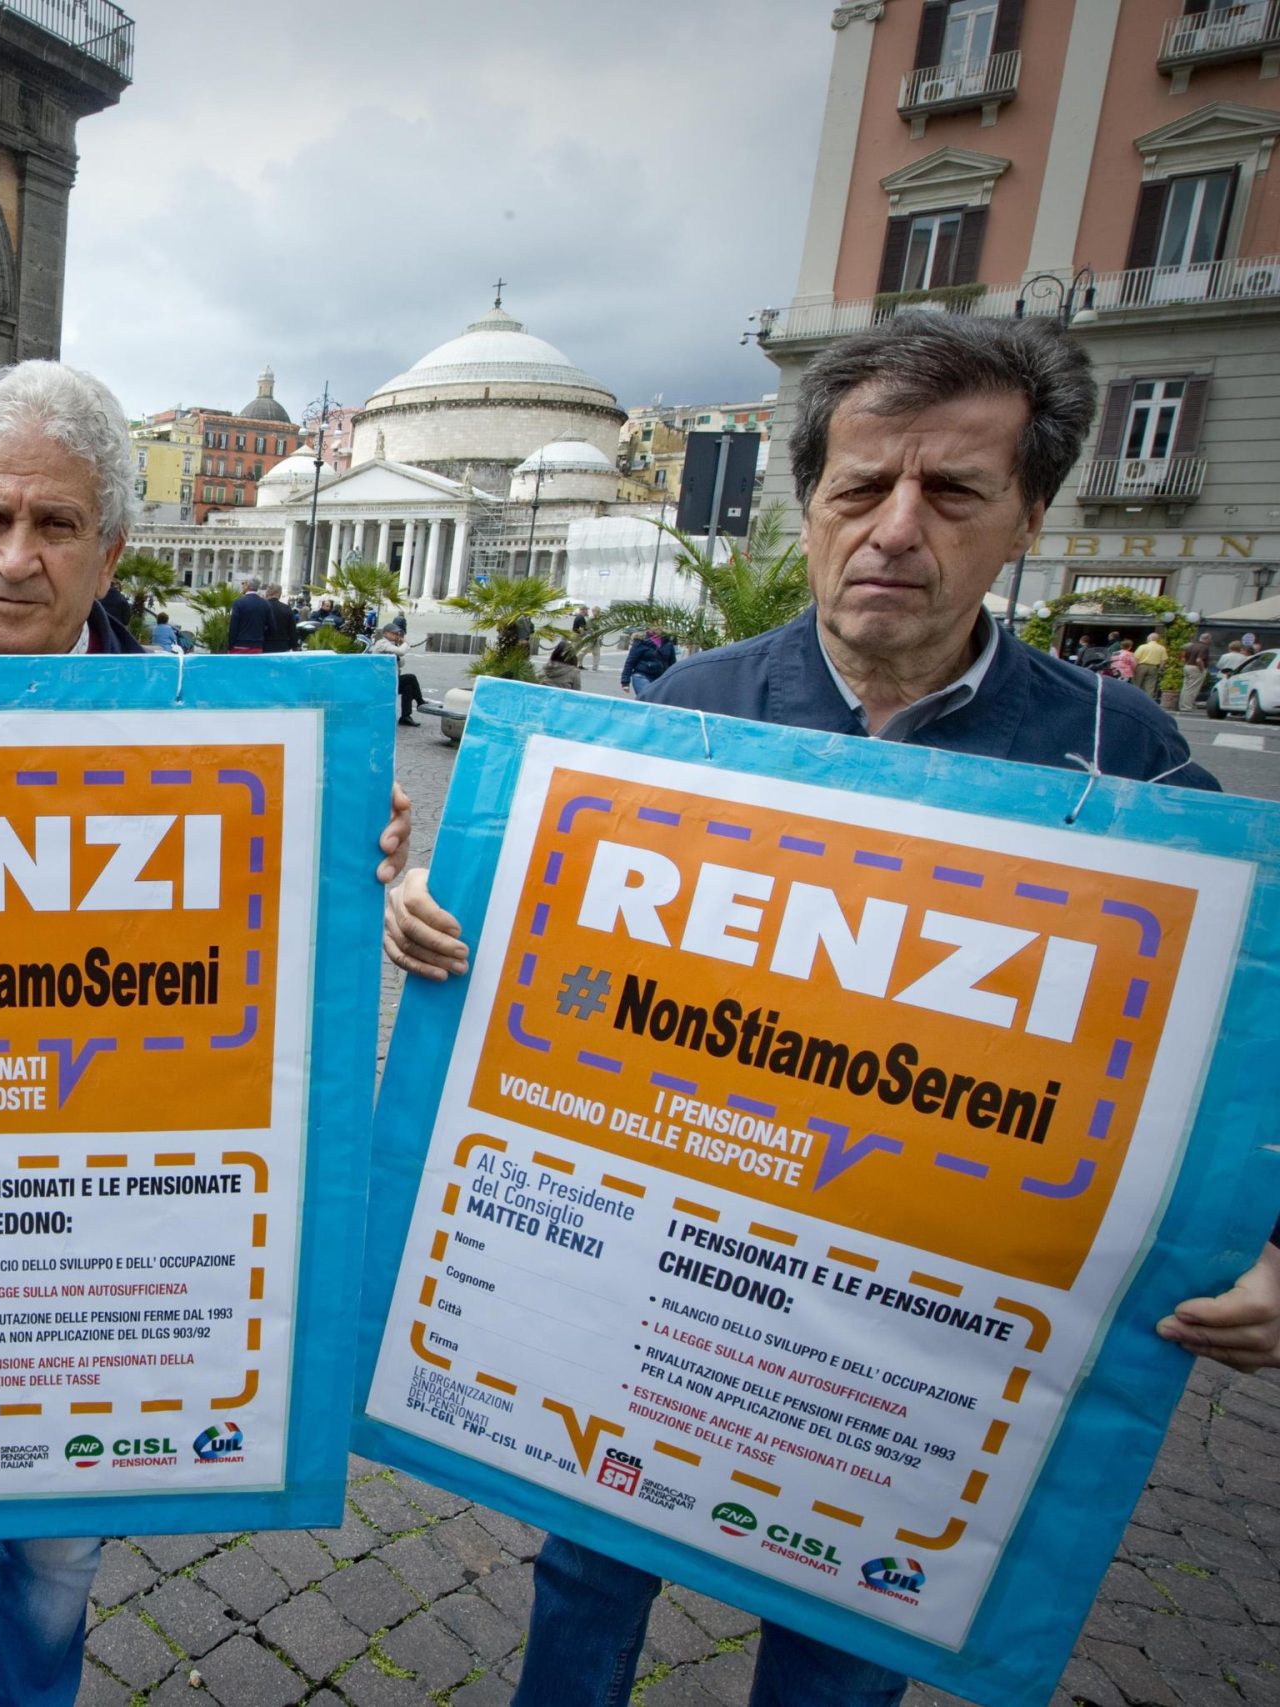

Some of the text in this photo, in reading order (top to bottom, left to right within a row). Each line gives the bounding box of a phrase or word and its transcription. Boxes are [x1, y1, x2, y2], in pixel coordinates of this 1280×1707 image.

[577, 839, 1097, 1043] RENZI
[499, 1073, 804, 1188] VOGLIONO DELLE RISPOSTE
[654, 1090, 813, 1159] I PENSIONATI
[81, 1177, 92, 1196] E
[98, 1177, 120, 1196] LE
[126, 1174, 241, 1195] PENSIONATE
[477, 1153, 635, 1221] Al Sig. Presidente
[472, 1175, 584, 1229] del Consiglio
[467, 1195, 604, 1259] MATTEO RENZI
[454, 1231, 485, 1251] Nome
[21, 1258, 56, 1271] DELLO
[59, 1257, 112, 1270] SVILUPPO
[115, 1257, 122, 1269] E
[125, 1256, 156, 1269] DELL'
[159, 1254, 235, 1268] OCCUPAZIONE
[446, 1265, 496, 1293] Cognome
[658, 1250, 794, 1314] CHIEDONO:
[667, 1219, 1014, 1342] I PENSIONATI E LE PENSIONATE
[22, 1285, 58, 1297] SULLA
[61, 1284, 84, 1296] NON
[87, 1283, 188, 1296] AUTOSUFFICIENZA
[54, 1311, 87, 1323] DELLE
[90, 1310, 140, 1322] PENSIONI
[143, 1309, 180, 1321] FERME
[182, 1308, 204, 1320] DAL
[207, 1307, 232, 1319] 1993
[437, 1299, 462, 1317] Città
[9, 1330, 32, 1343] NON
[35, 1328, 114, 1342] APPLICAZIONE
[117, 1328, 138, 1340] DEL
[141, 1327, 170, 1339] DLGS
[172, 1326, 210, 1338] 903/92
[429, 1331, 459, 1352] Firma
[37, 1356, 74, 1368] ANCHE
[77, 1356, 88, 1367] AI
[92, 1354, 156, 1367] PENSIONATI
[159, 1353, 194, 1365] DELLA
[29, 1374, 62, 1386] DELLE
[65, 1373, 100, 1385] TASSE
[646, 1346, 956, 1462] RIVALUTAZIONE DELLE PENSIONI FERME DAL 1993
[112, 1437, 177, 1455] CISL
[211, 1438, 242, 1451] UIL
[406, 1398, 577, 1474] SPI-CGIL FNP-CISL UILP-UIL
[0, 1445, 50, 1454] SINDACATO
[0, 1453, 50, 1462] PENSIONATI
[69, 1443, 100, 1453] FNP
[606, 1447, 643, 1469] CGIL
[0, 1460, 34, 1469] ITALIANI
[112, 1457, 177, 1468] PENSIONATI
[194, 1456, 244, 1464] PENSIONATI
[717, 1507, 753, 1526] FNP
[766, 1524, 842, 1566] CISL
[883, 1570, 921, 1594] UIL
